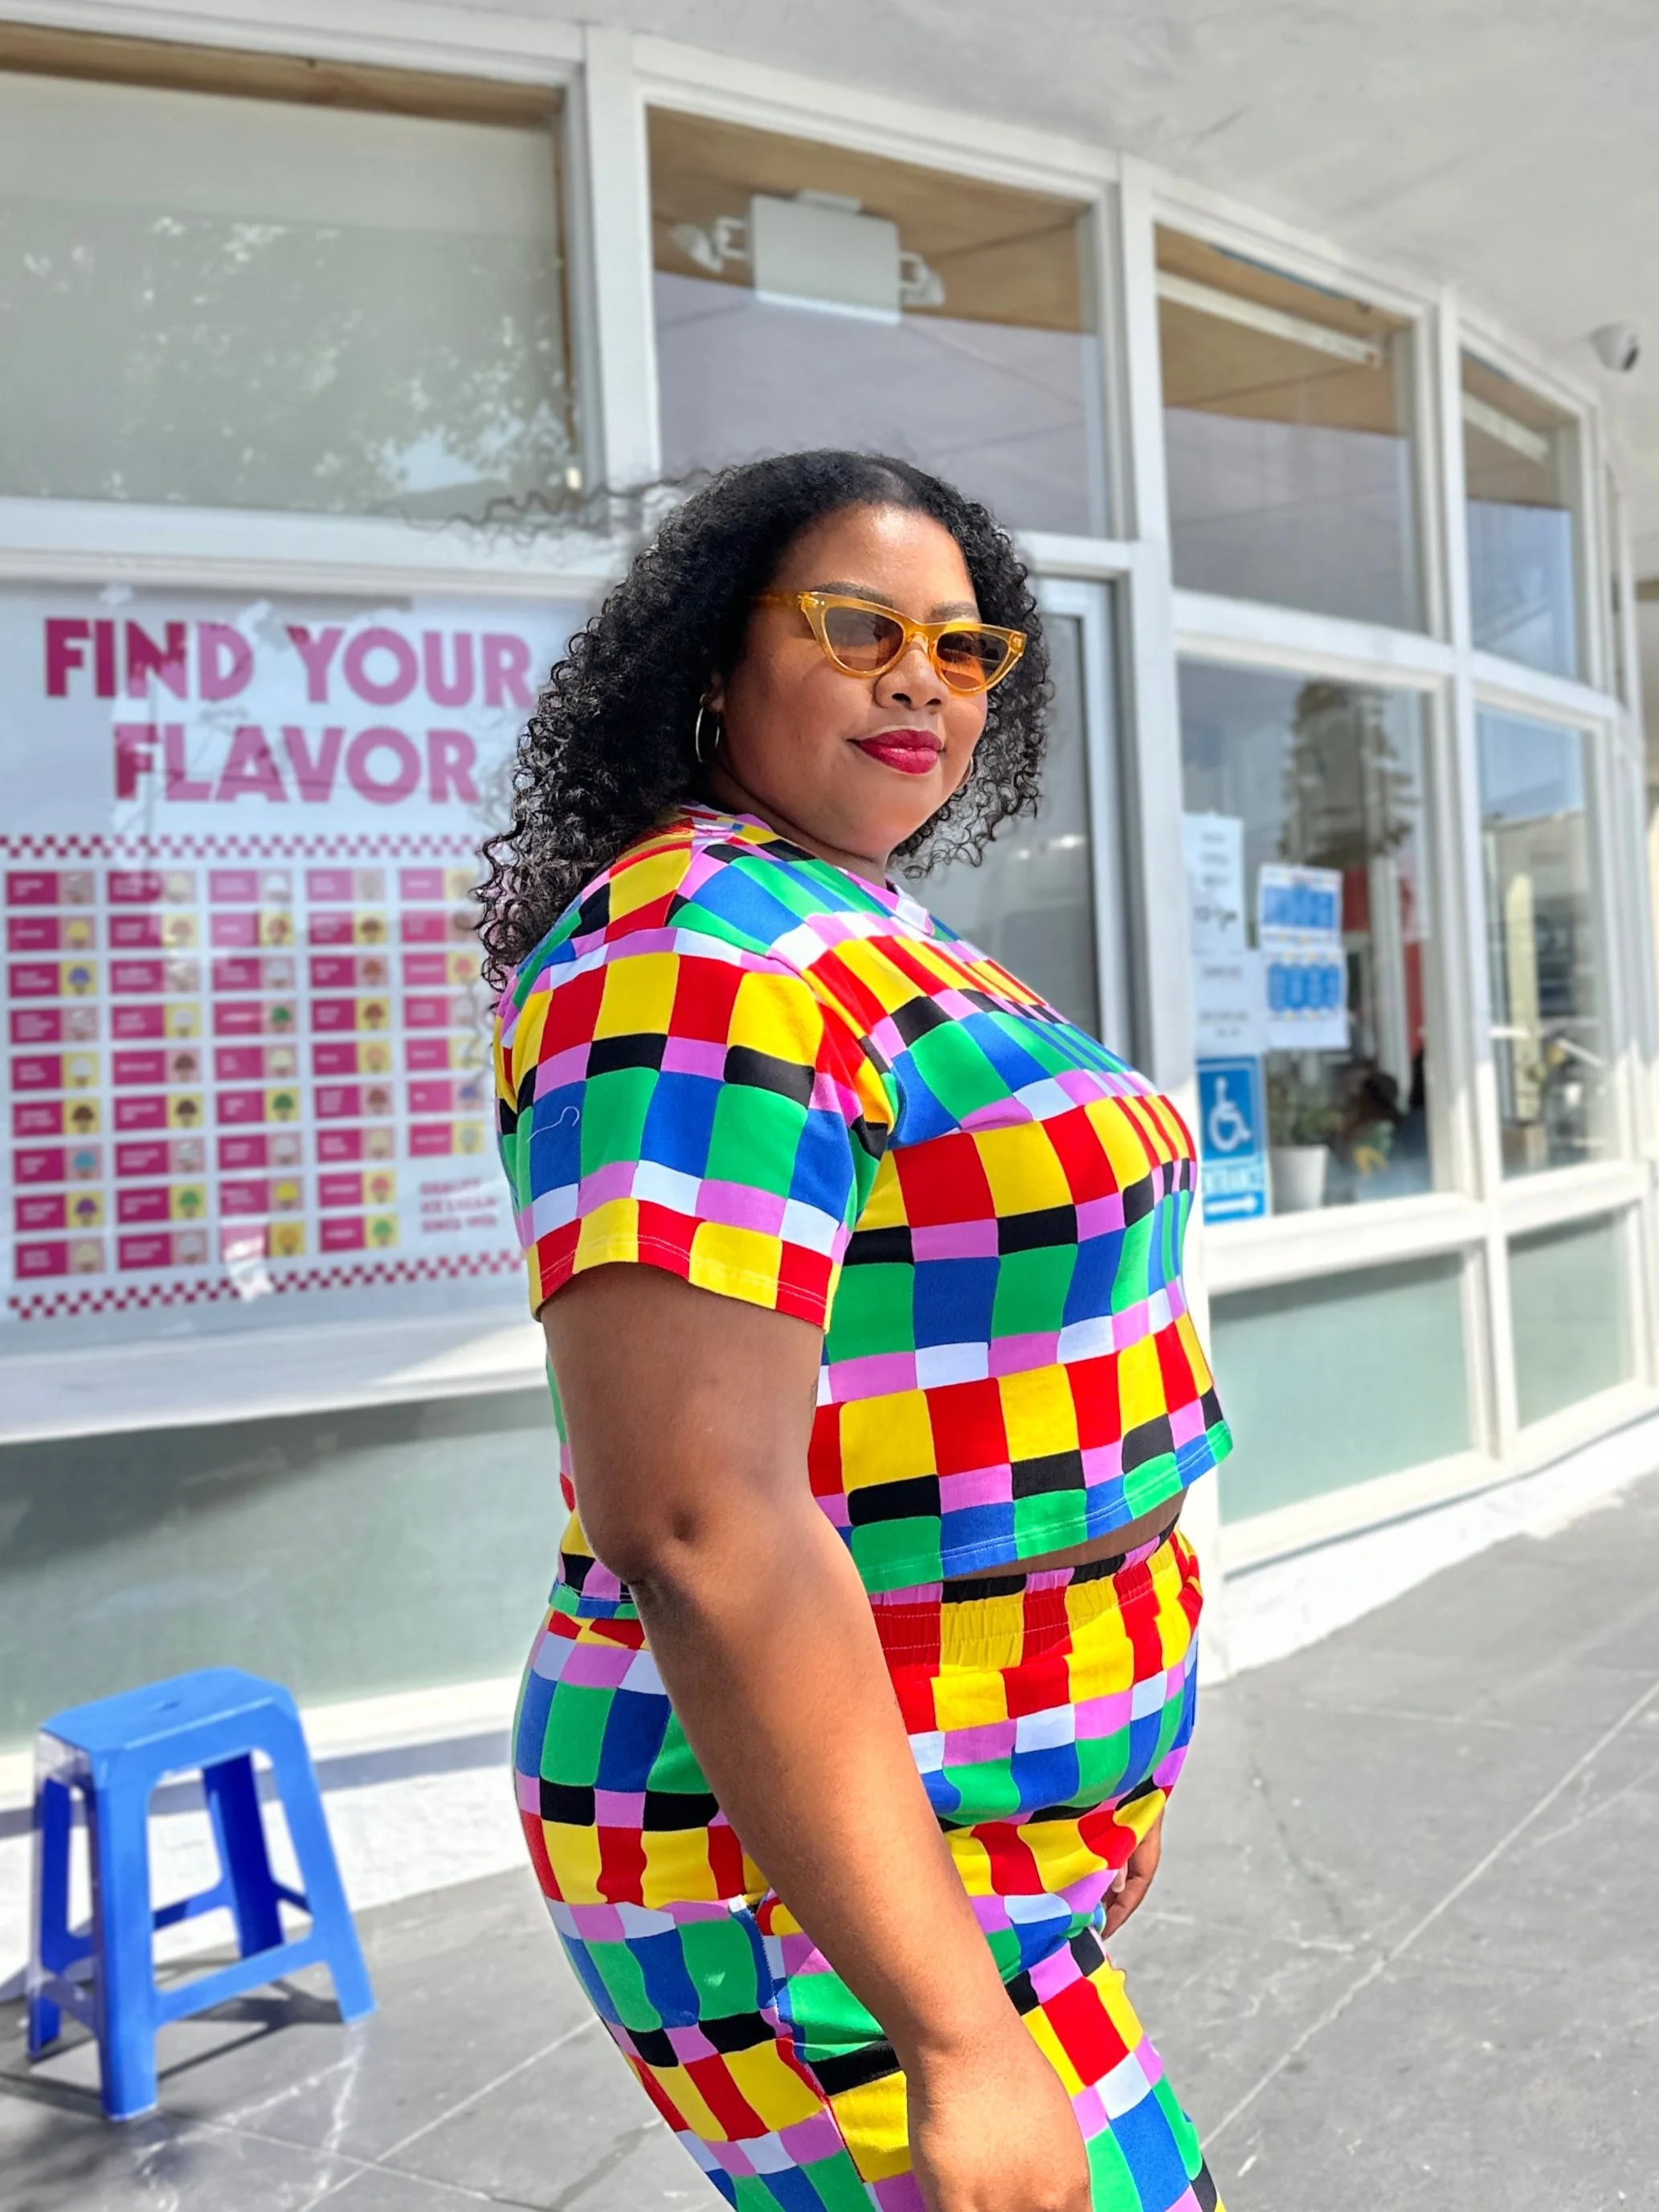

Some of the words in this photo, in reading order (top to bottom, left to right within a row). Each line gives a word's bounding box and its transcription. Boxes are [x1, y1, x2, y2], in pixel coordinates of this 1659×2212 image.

[44, 617, 254, 700] FIND
[286, 626, 535, 708] YOUR
[114, 724, 481, 804] FLAVOR
